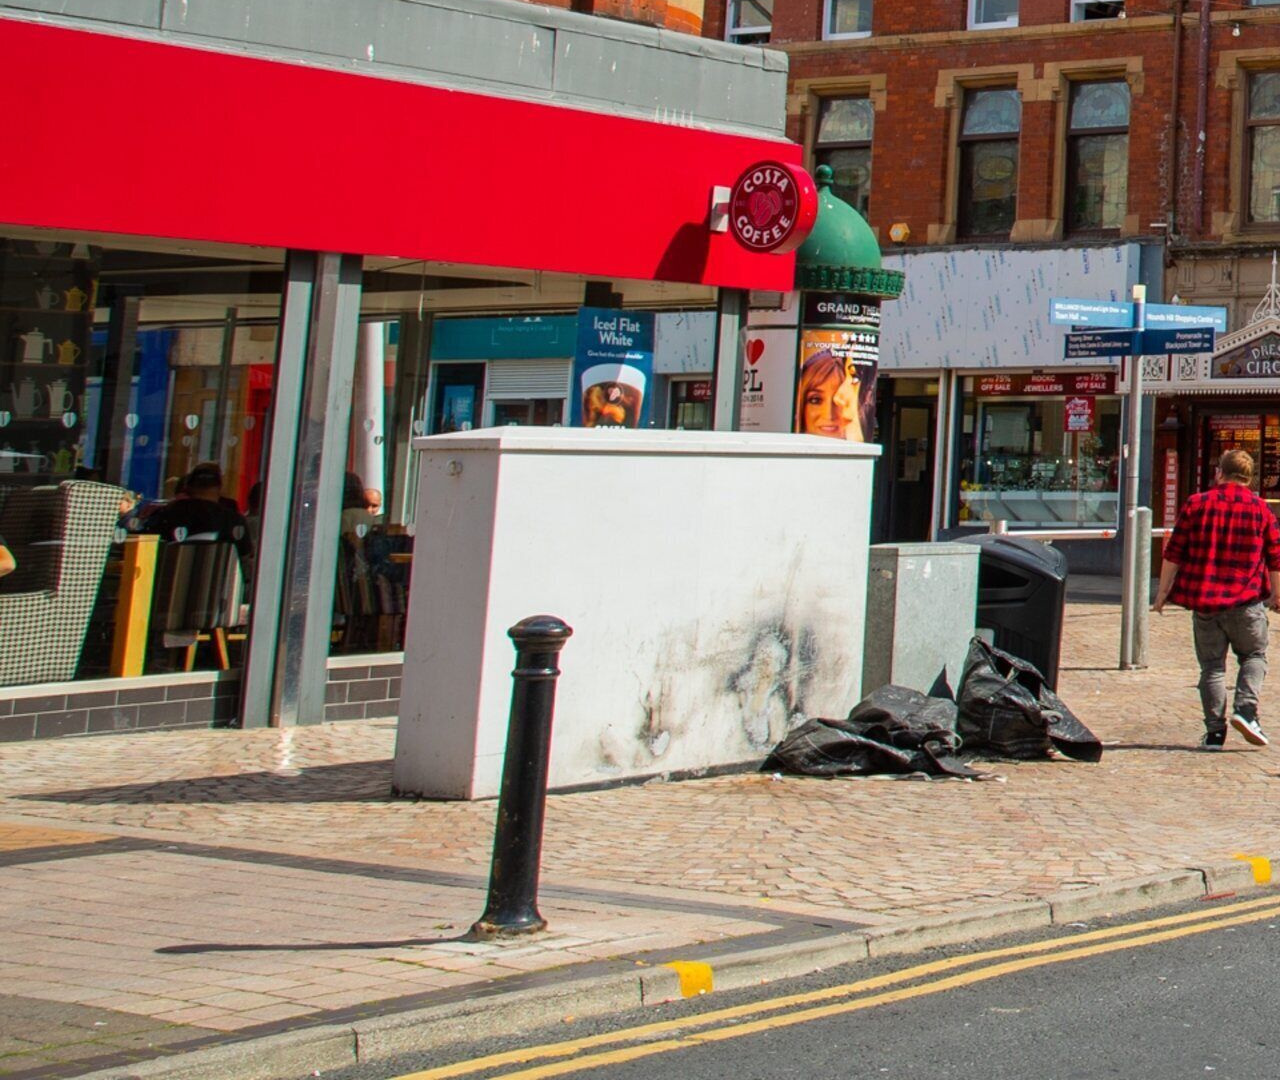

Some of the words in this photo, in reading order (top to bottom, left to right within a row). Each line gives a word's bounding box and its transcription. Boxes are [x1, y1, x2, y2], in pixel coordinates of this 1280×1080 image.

[743, 169, 789, 193] COSTA
[737, 215, 790, 244] COFFEE
[816, 302, 860, 314] GRAND
[1055, 312, 1069, 320] Town
[1070, 312, 1080, 320] Hall
[1174, 314, 1197, 323] Shopping
[1198, 315, 1214, 324] Centre
[594, 316, 617, 331] Iced
[620, 318, 640, 332] Flat
[599, 331, 633, 347] White
[1176, 332, 1202, 340] Promenade
[1165, 341, 1188, 350] Blackpool
[1189, 340, 1202, 348] Tower
[1024, 384, 1063, 392] JEWELLERS
[1090, 382, 1106, 390] SALE
